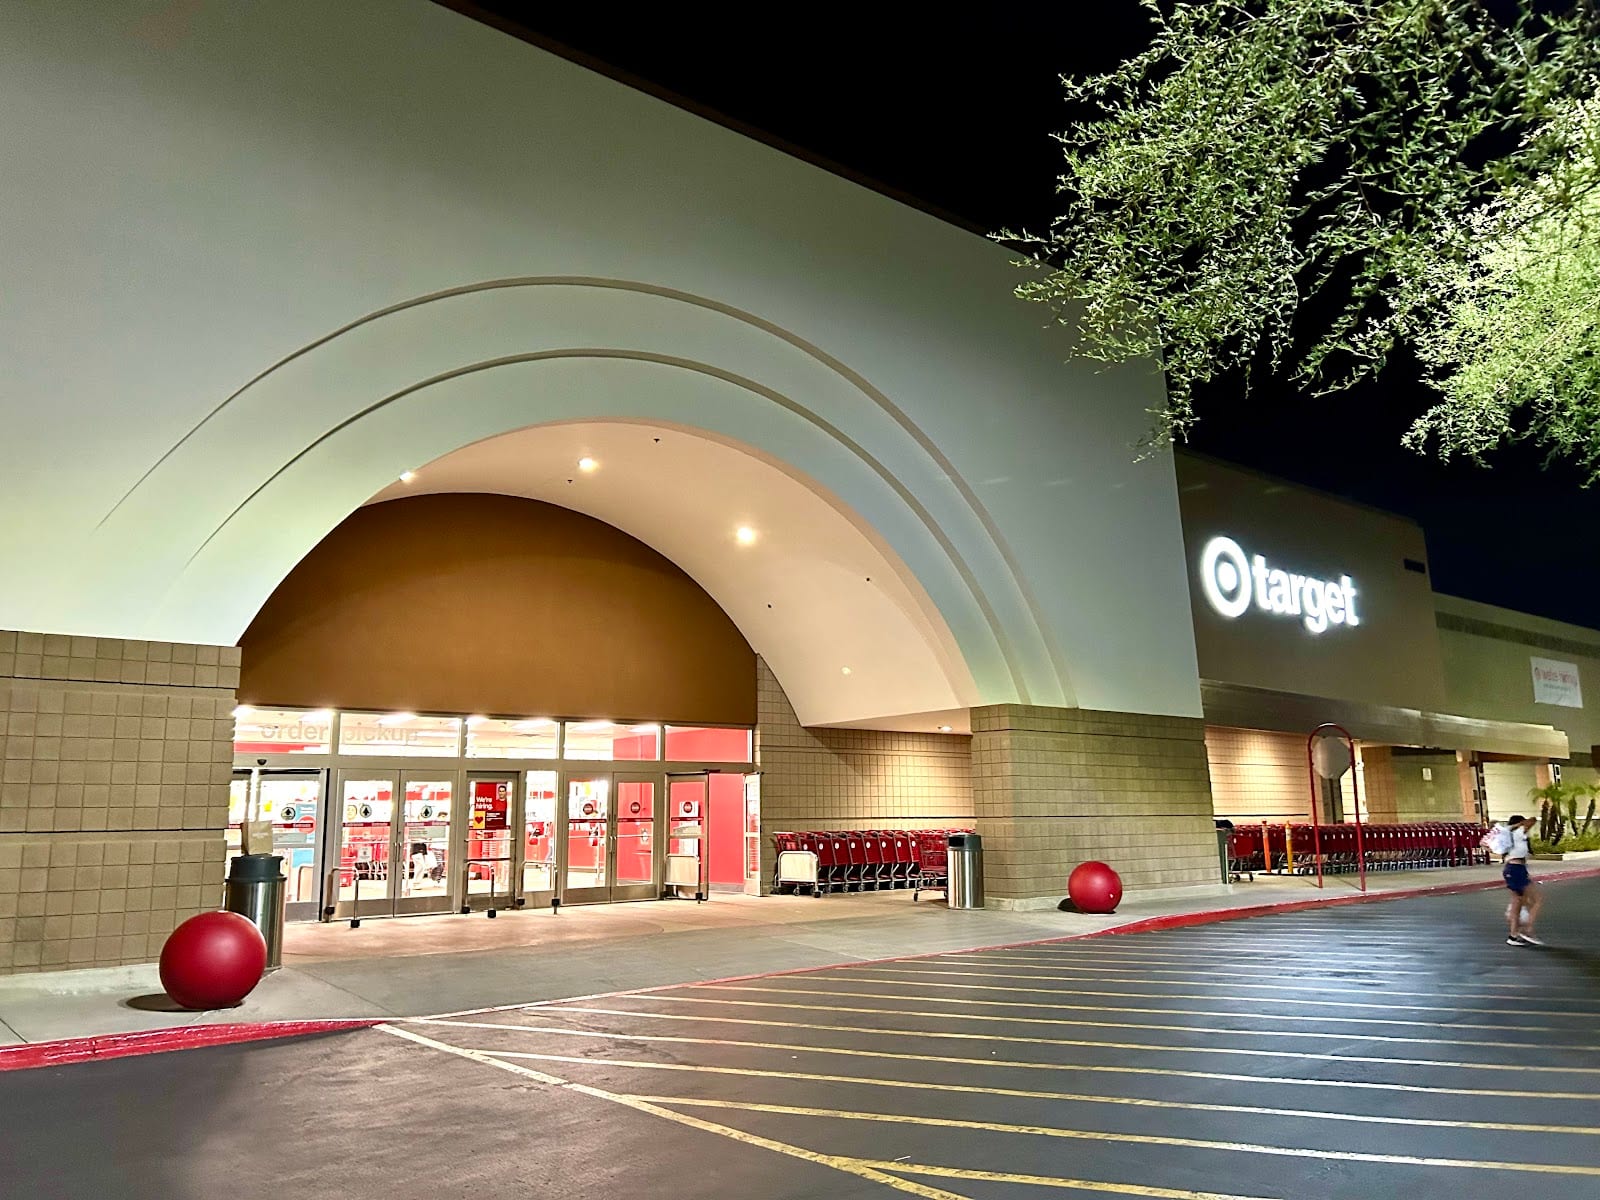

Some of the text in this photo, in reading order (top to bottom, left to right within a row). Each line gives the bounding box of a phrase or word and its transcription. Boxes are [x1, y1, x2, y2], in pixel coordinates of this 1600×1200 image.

[1252, 554, 1360, 633] target
[260, 720, 418, 746] order pickup
